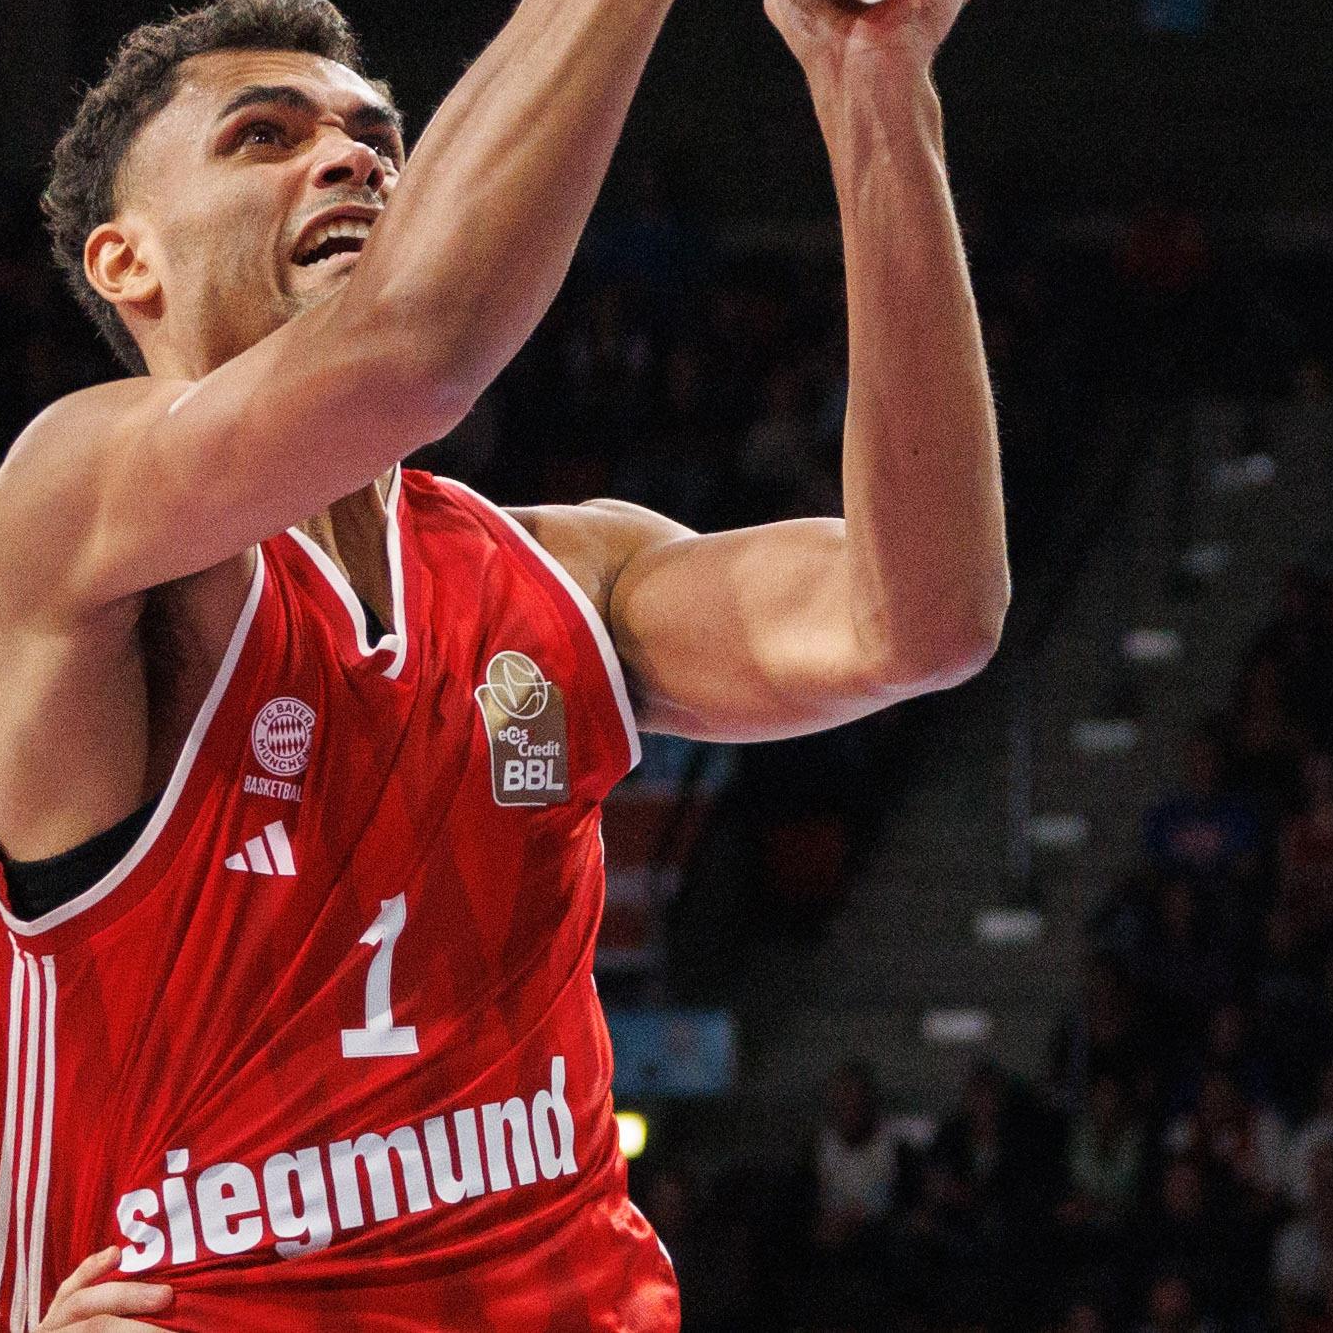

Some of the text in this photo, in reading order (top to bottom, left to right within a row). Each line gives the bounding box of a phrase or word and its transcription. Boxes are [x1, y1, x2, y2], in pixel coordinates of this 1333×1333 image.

[261, 709, 275, 726] FC
[518, 740, 560, 757] Credit
[244, 774, 303, 803] BASKETBAL
[503, 759, 563, 791] BBL
[343, 891, 419, 1058] 1
[115, 1055, 578, 1273] siegmund
